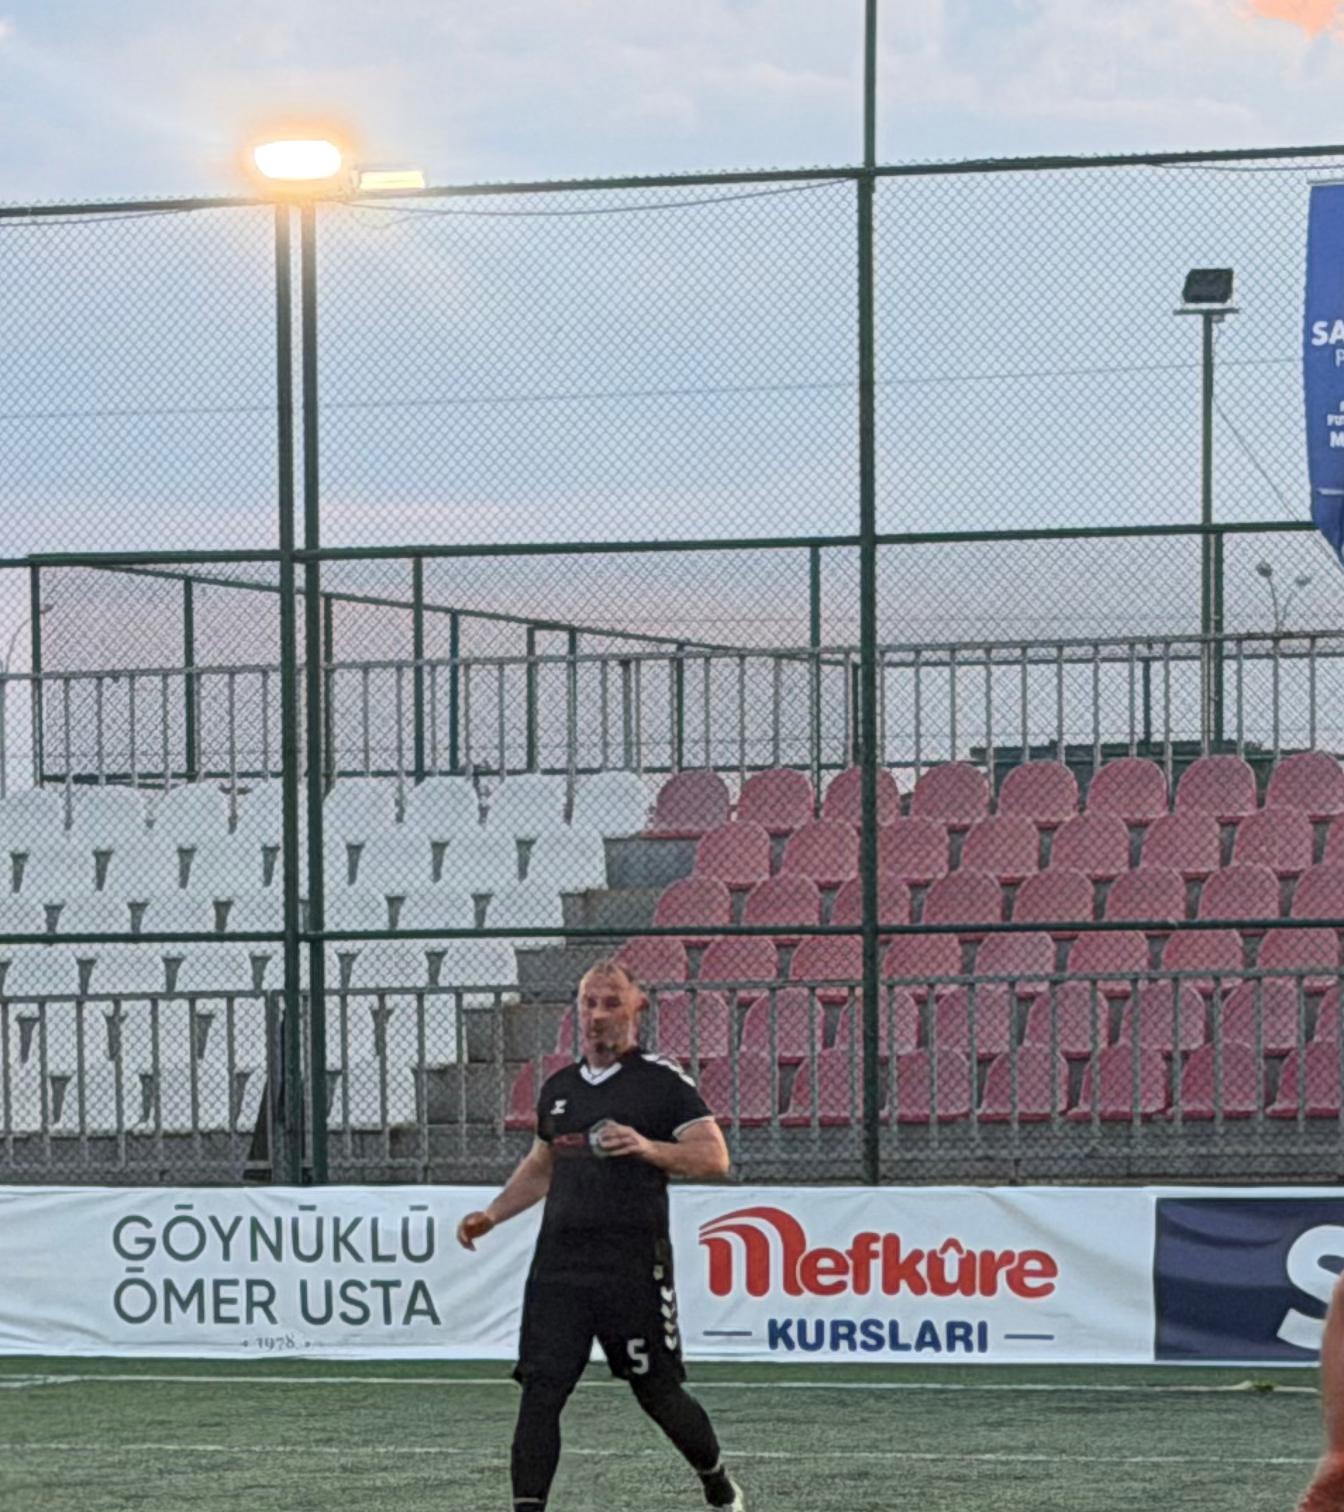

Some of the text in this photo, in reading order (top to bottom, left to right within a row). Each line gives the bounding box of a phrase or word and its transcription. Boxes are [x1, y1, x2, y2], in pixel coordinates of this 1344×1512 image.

[299, 1279, 441, 1325] USTA
[768, 1318, 988, 1353] KURSLARI
[627, 1338, 649, 1375] 5
